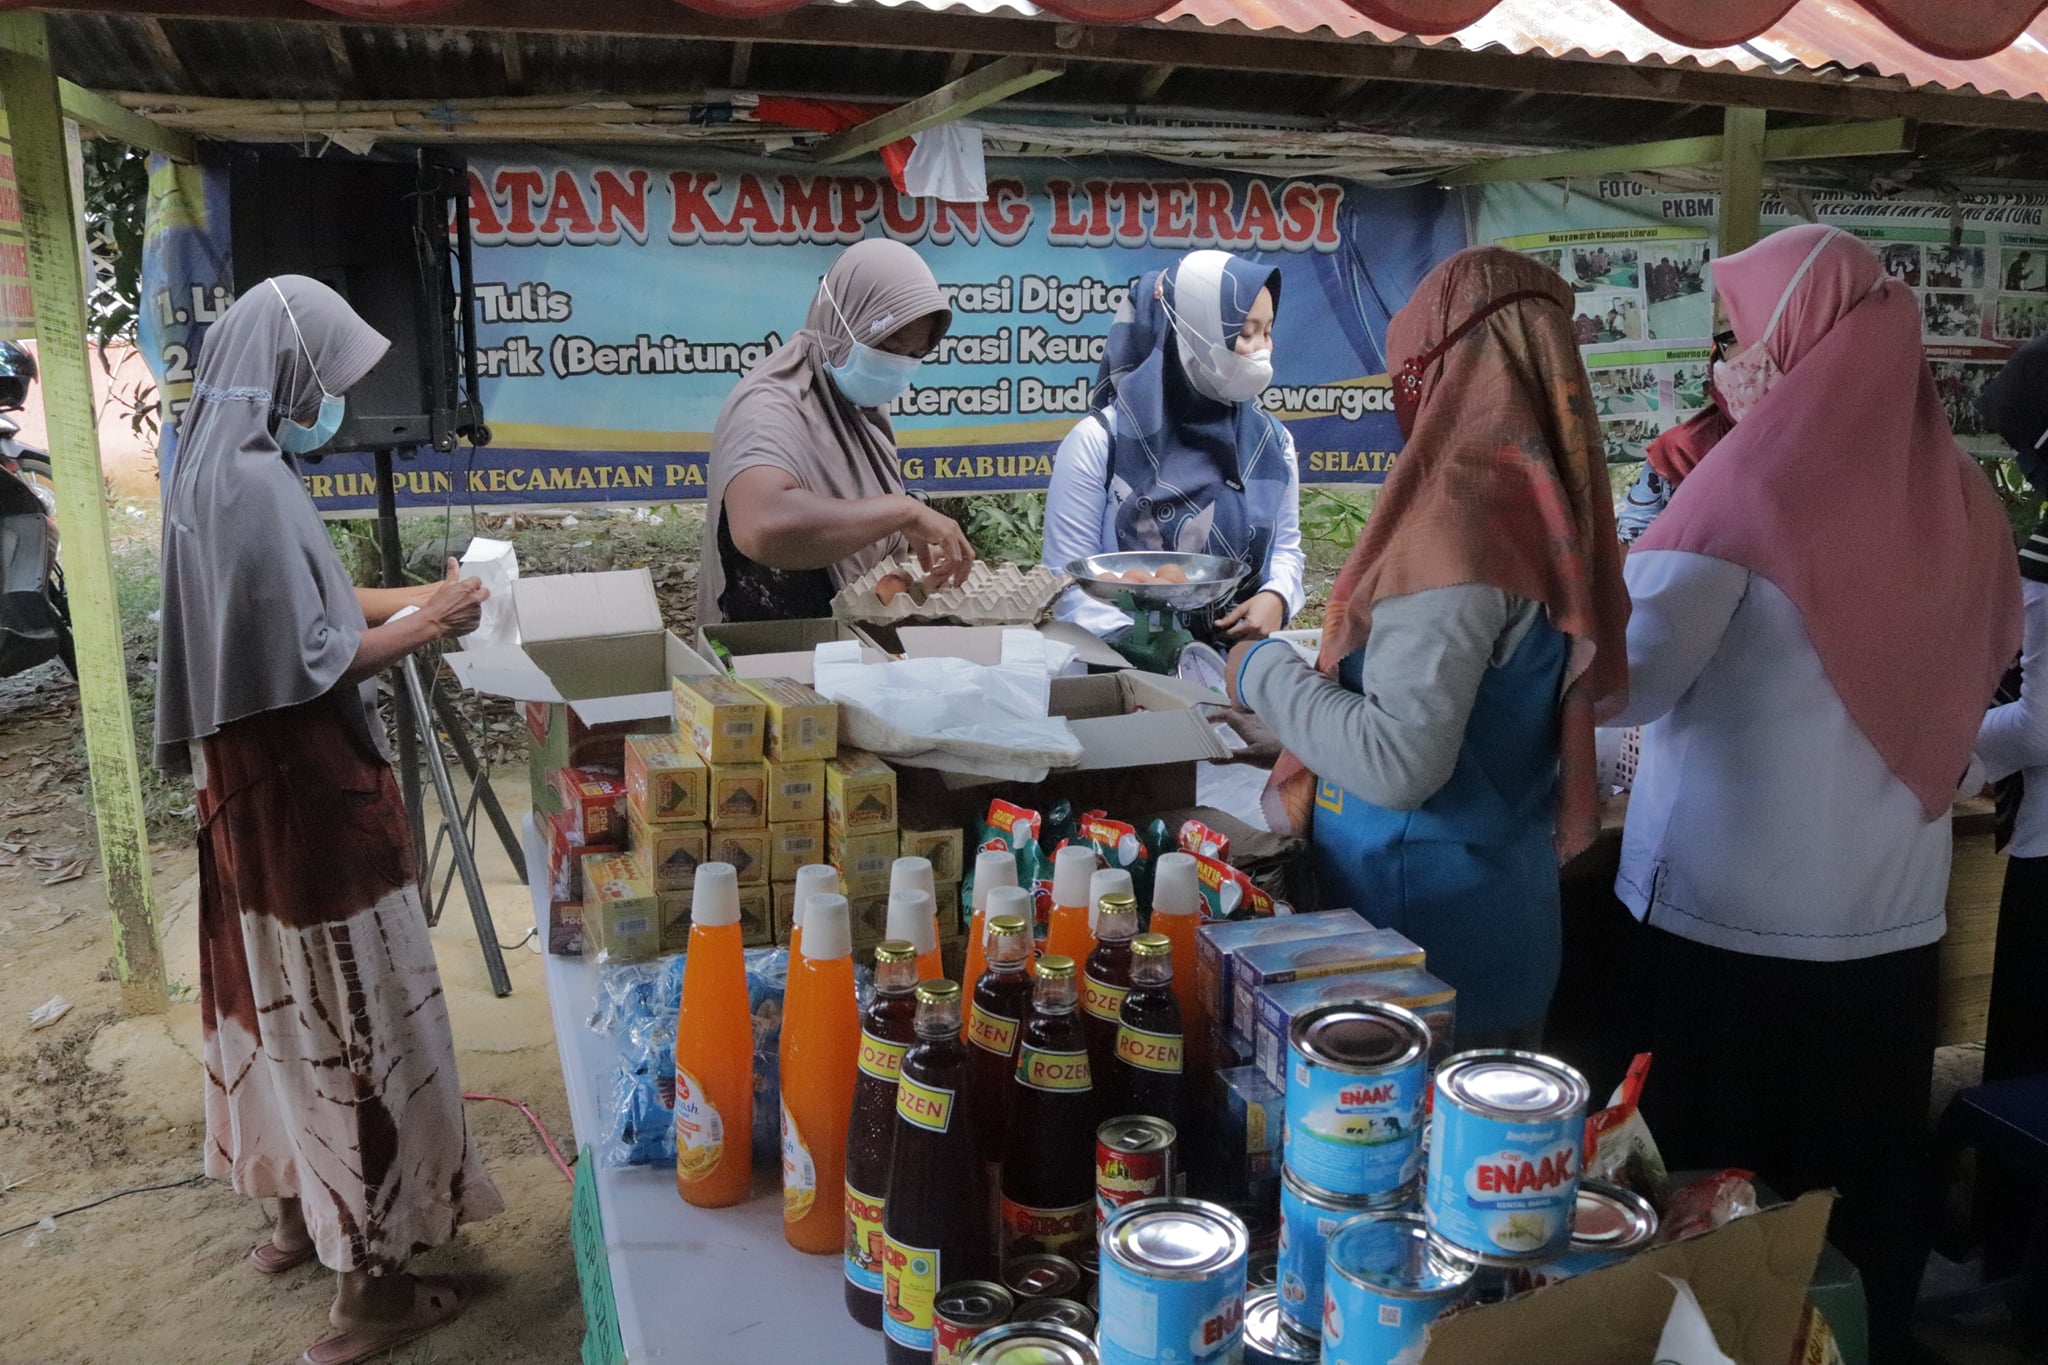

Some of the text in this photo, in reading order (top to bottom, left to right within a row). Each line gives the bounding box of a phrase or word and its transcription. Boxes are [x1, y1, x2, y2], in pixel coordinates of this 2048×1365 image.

[1598, 180, 1655, 199] FOTO-
[449, 166, 1345, 252] ATAN KAMPUNG LITERASI
[1662, 198, 2043, 226] PKBM KECAMATAN PADNG BATUNG
[475, 281, 572, 323] Tulis
[1019, 274, 1140, 325] Digita
[460, 336, 545, 377] erik
[466, 464, 654, 494] KECAMATAN
[933, 455, 1057, 480] KABUPA
[1308, 451, 1398, 472] SELATA
[1197, 860, 1222, 884] RATIS
[562, 916, 583, 926] POC
[968, 1013, 1009, 1045] OZEN
[1119, 1034, 1180, 1064] ROZEN
[1033, 1061, 1091, 1081] ROZEN
[898, 1085, 943, 1119] OZEN
[1340, 1083, 1398, 1106] ENAAK
[1476, 1147, 1575, 1195] ENAAK
[1501, 1151, 1521, 1162] Cap
[1203, 1298, 1243, 1346] ENA
